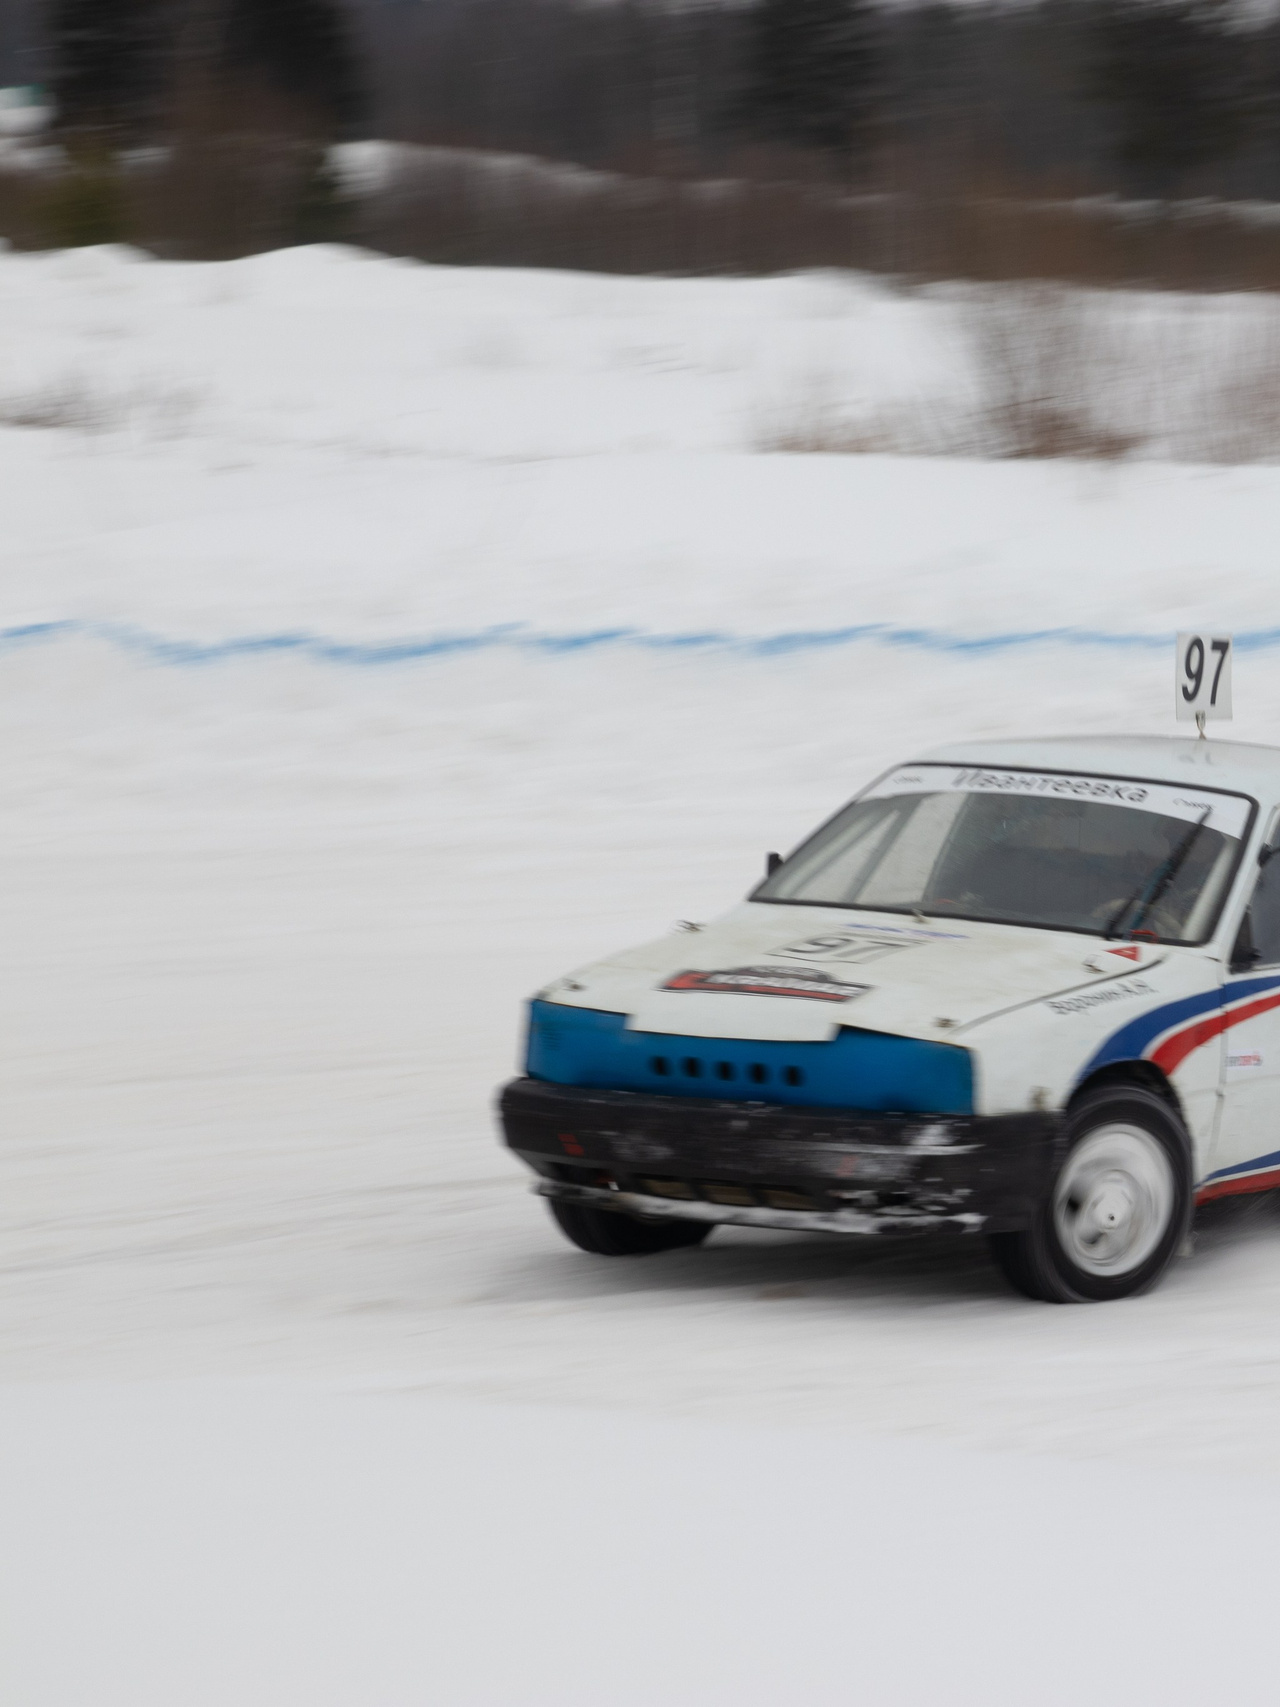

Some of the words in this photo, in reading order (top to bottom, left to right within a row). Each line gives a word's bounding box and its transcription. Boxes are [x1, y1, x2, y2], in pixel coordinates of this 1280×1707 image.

[1182, 635, 1230, 706] 97
[951, 768, 1150, 804] Ивантеевка
[785, 936, 911, 959] 97
